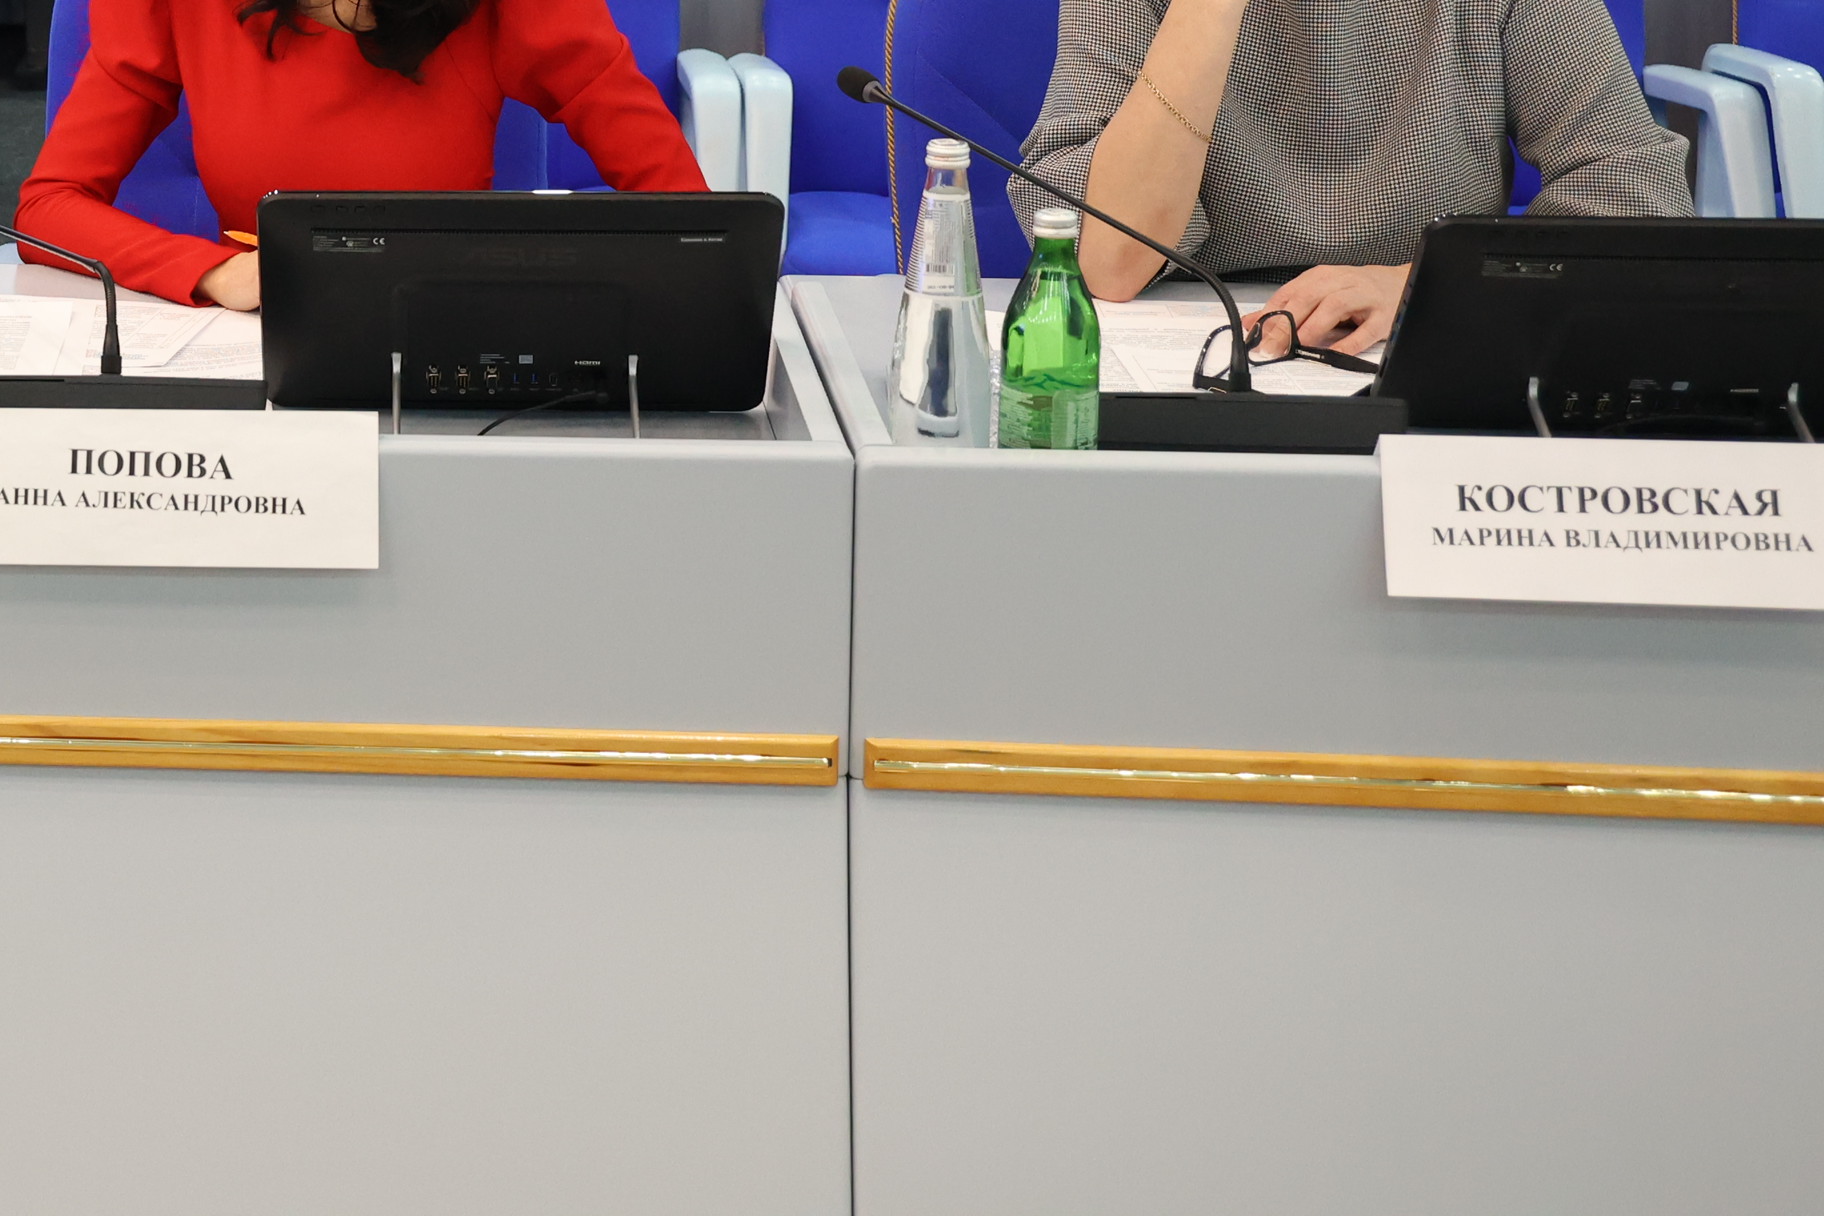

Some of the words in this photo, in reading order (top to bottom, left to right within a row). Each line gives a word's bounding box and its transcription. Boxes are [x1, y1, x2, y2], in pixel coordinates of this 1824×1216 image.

[68, 448, 234, 481] ПОПОВА
[74, 490, 307, 516] АЛЕКСАНДРОВНА
[1456, 484, 1782, 517] КОСТРОВСКАЯ
[1430, 526, 1556, 548] МАРИНА
[1564, 529, 1815, 553] ВЛАДИМИРОВНА
